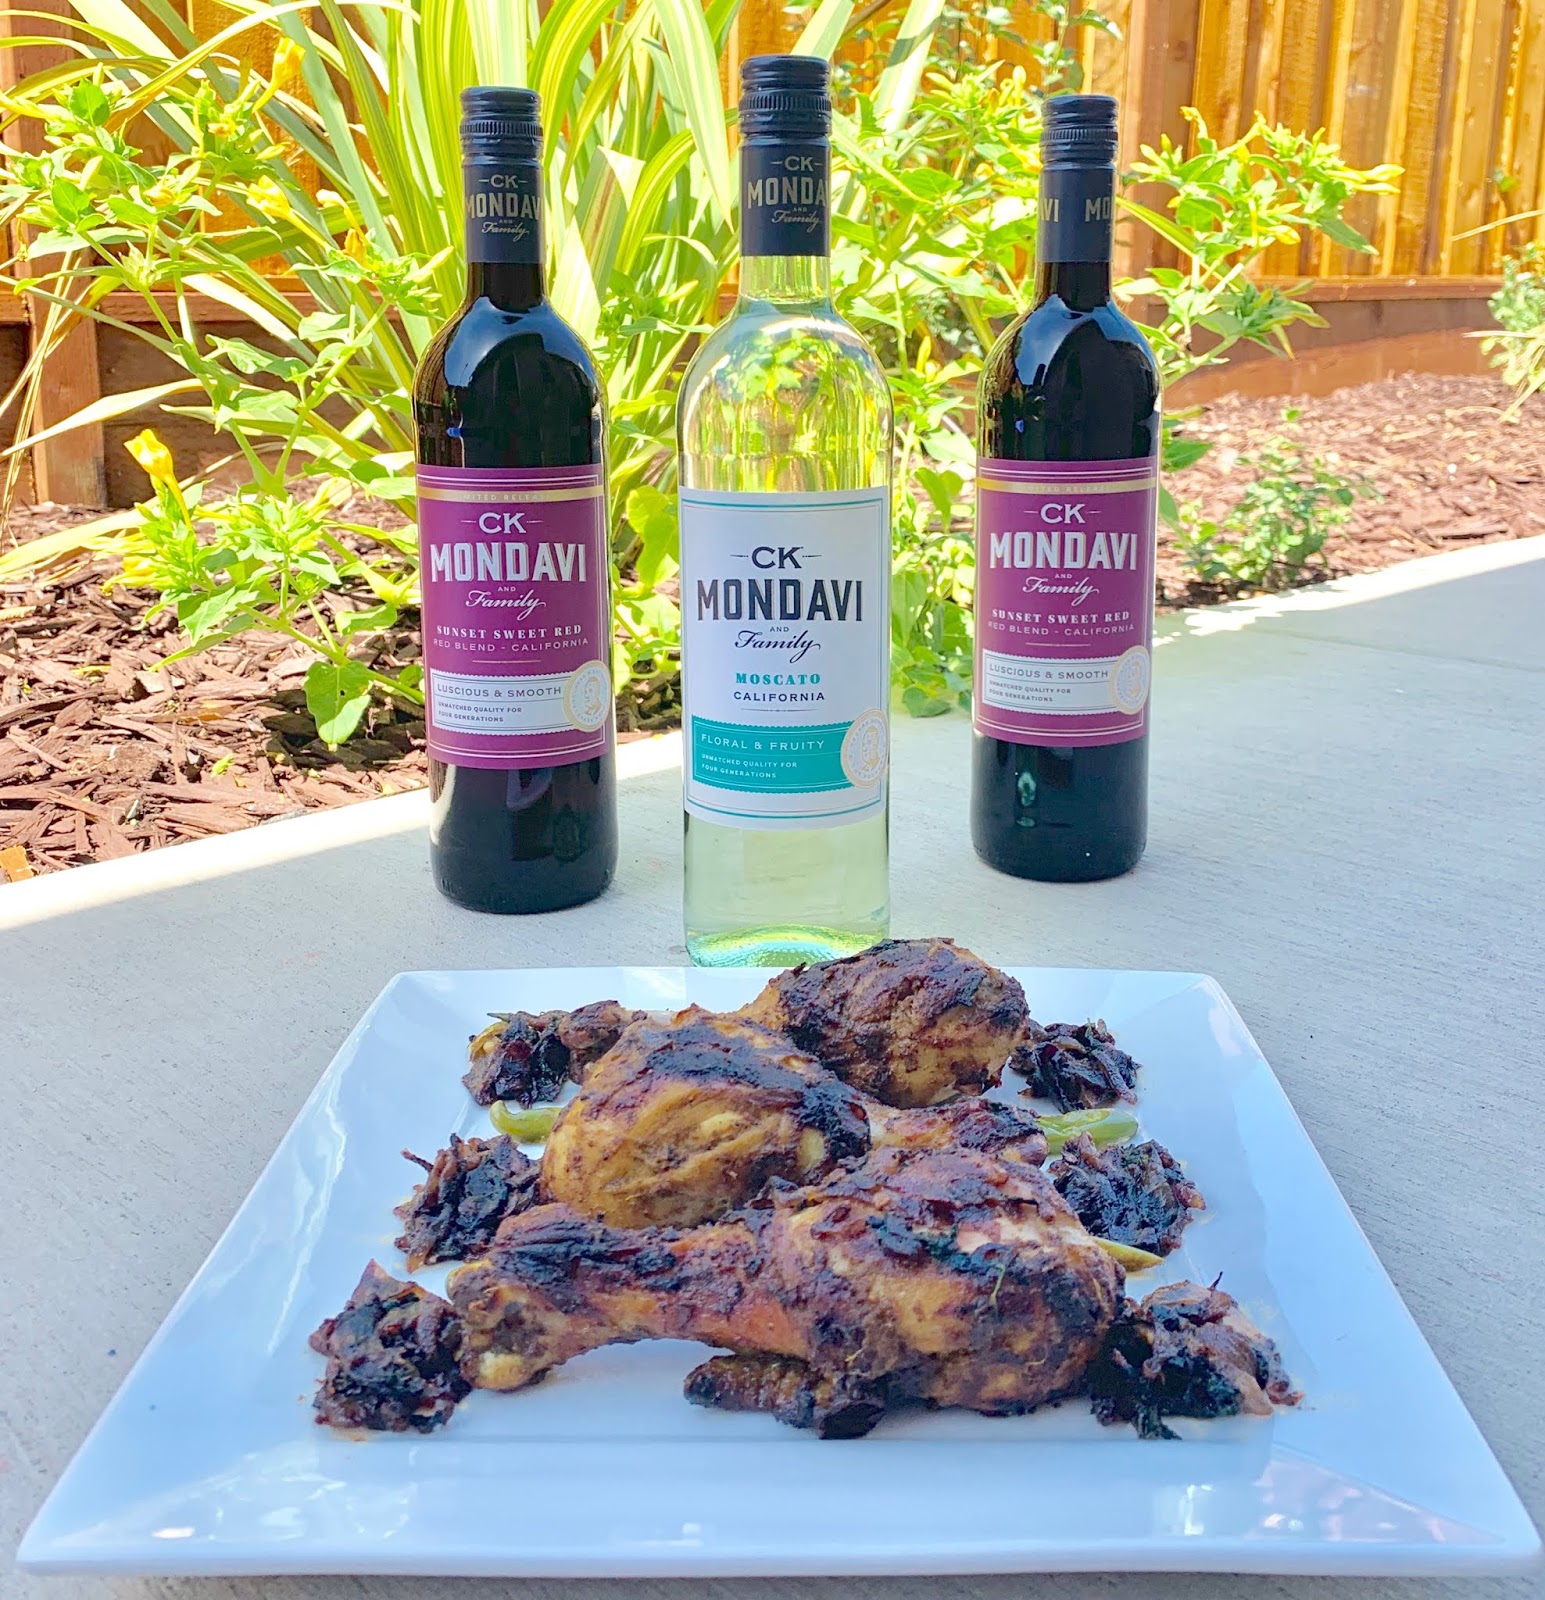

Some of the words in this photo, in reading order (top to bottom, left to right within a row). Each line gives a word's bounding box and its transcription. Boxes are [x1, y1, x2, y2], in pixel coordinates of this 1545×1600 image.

[784, 155, 814, 172] CK
[490, 174, 518, 188] CK
[771, 209, 821, 233] Family
[481, 221, 530, 242] Family
[1041, 503, 1086, 524] CK
[478, 512, 526, 534] CK
[751, 546, 803, 569] CK
[989, 532, 1138, 570] MONDAVI
[430, 542, 587, 583] MONDAVI
[697, 579, 863, 621] MONDAVI
[1022, 576, 1099, 607] Family
[465, 589, 547, 621] Family
[992, 609, 1042, 623] SUNSET
[1048, 615, 1098, 625] SWEET
[1104, 611, 1130, 622] RED
[436, 625, 487, 639] SUNSET
[493, 628, 547, 640] SWEET
[554, 624, 582, 637] RED
[988, 621, 1006, 631] RED
[1009, 625, 1049, 635] BLEND
[1064, 623, 1135, 636] CALIFORNIA
[433, 638, 451, 648] RED
[455, 641, 495, 652] BLEND
[512, 638, 589, 652] CALIFORNIA
[734, 630, 821, 664] Family
[735, 673, 821, 685] MOSCATO
[989, 663, 1041, 678] LUSCIOUS
[1045, 671, 1054, 679] &
[1058, 670, 1109, 680] SMOOTH
[437, 684, 489, 697] LUSCIOUS
[494, 690, 503, 698] &
[507, 686, 562, 698] SMOOTH
[733, 691, 825, 702] CALIFORNIA
[1005, 692, 1053, 702] GENERATIONS
[438, 701, 472, 711] UNMATCHED
[454, 714, 504, 722] GENERATIONS
[701, 733, 748, 749] FLORAL
[754, 742, 763, 750] &
[770, 740, 825, 751] FRUITY
[701, 753, 741, 766] UNMATCHED
[743, 760, 778, 768] QUALITY
[701, 763, 718, 772] FOUR
[720, 768, 777, 778] GENERATIONS
